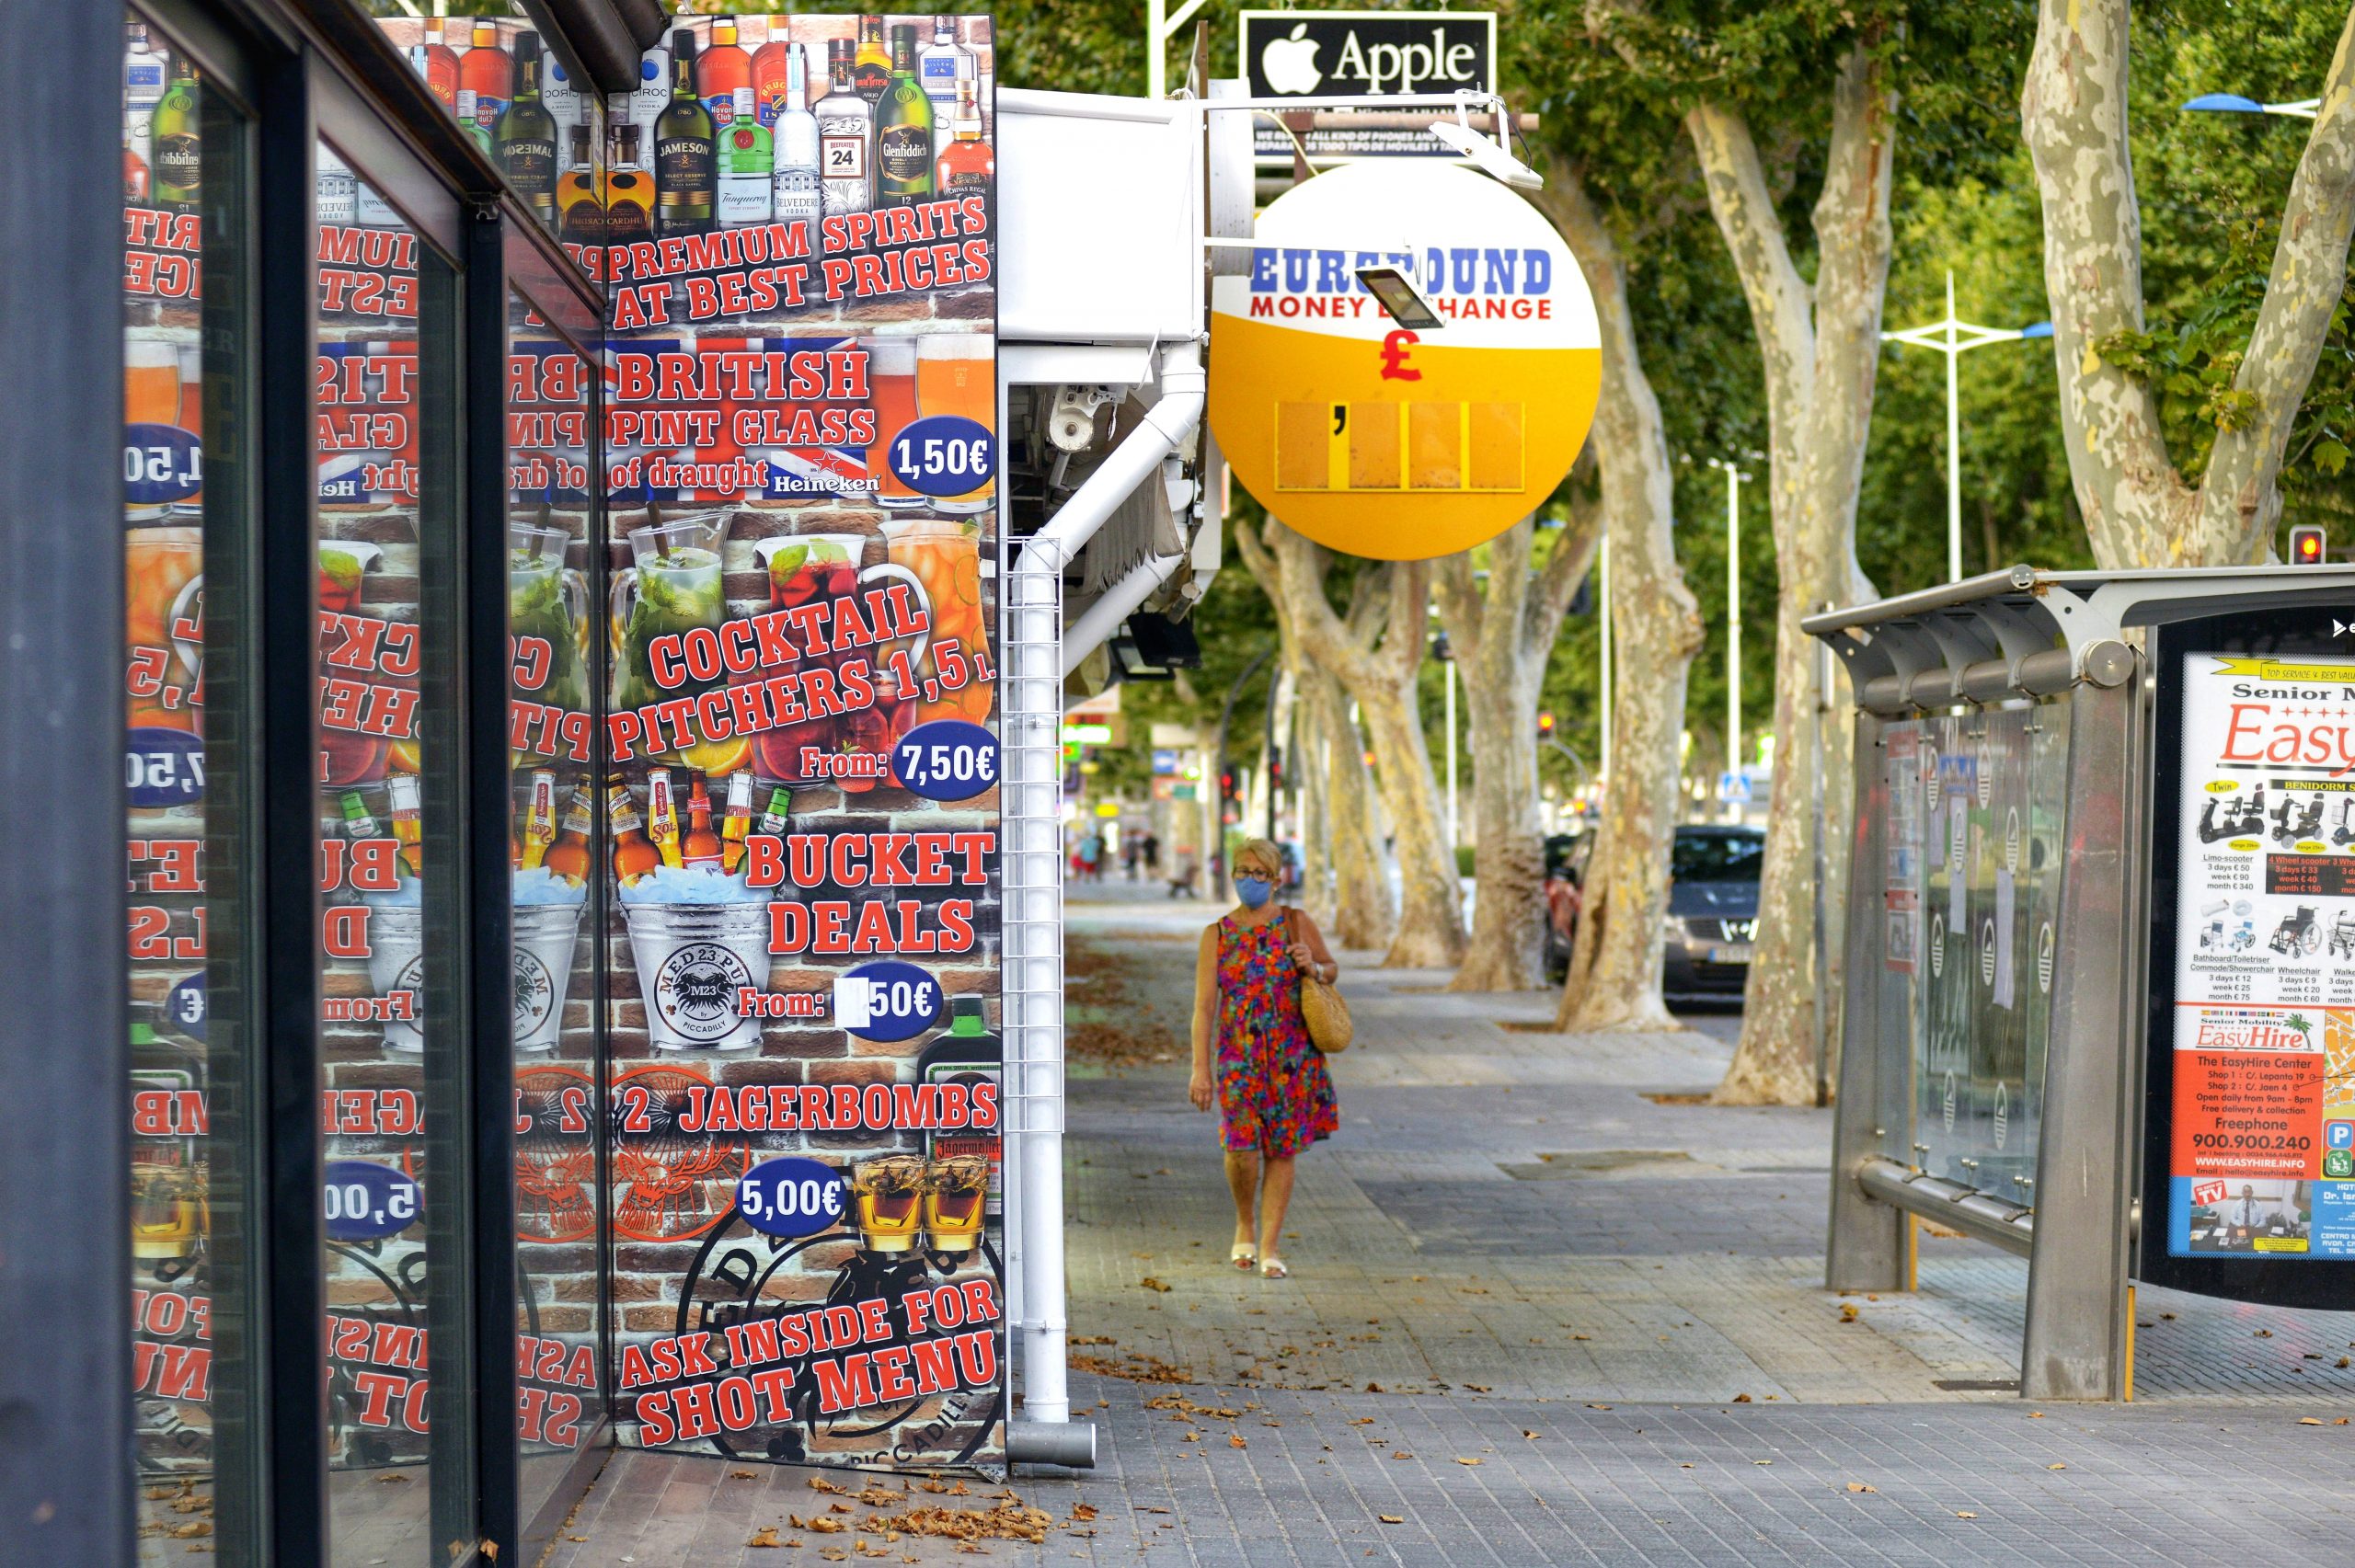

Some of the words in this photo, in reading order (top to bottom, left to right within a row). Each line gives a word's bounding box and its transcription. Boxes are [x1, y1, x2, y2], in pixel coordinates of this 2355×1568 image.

[1330, 28, 1476, 95] Apple
[711, 106, 733, 114] Havan
[660, 143, 710, 157] JAMESON
[832, 150, 854, 166] 24
[883, 143, 927, 157] Glenfiddich
[721, 192, 767, 205] Tanqueray
[948, 186, 969, 195] CHIVAS
[969, 186, 986, 194] REGAL
[902, 196, 911, 204] 12
[608, 221, 810, 281] PREMIUM
[821, 196, 987, 253] SPIRITS
[614, 282, 672, 331] AT
[687, 264, 809, 320] BEST
[821, 239, 992, 301] PRICES
[1249, 295, 1367, 318] MONEY
[1378, 297, 1552, 320] HANGE
[615, 350, 870, 401] BRITISH
[612, 410, 720, 447] PINT
[734, 408, 876, 446] GLASS
[896, 439, 989, 481] 1,50€
[611, 456, 642, 489] of
[649, 457, 769, 495] draught
[774, 475, 881, 493] Heineken
[649, 583, 929, 689] COCKTAIL
[2282, 670, 2311, 679] SERVICE
[2320, 671, 2337, 680] BEST
[607, 659, 875, 762] PITCHERS
[890, 639, 969, 703] 1,5
[2232, 683, 2332, 701] Senior
[799, 746, 889, 780] From:
[902, 744, 995, 786] 7,50€
[2212, 783, 2233, 792] Twin
[2284, 782, 2346, 792] BENIDORM
[745, 832, 995, 888] BUCKET
[2202, 853, 2254, 863] Limo-scooter
[2276, 856, 2299, 864] Wheel
[2301, 857, 2330, 865] scooter
[2213, 864, 2232, 872] days
[766, 898, 975, 955] DEALS
[660, 952, 695, 994] MED
[697, 948, 717, 962] 23
[2278, 967, 2321, 976] Wheelchair
[691, 986, 717, 996] M23
[737, 987, 825, 1018] From:
[683, 1020, 726, 1033] PICCADILLY
[2238, 1019, 2283, 1027] Mobility
[2197, 1025, 2303, 1050] EasyHire
[2198, 1056, 2218, 1067] The
[2222, 1057, 2270, 1070] EasyHire
[2275, 1058, 2312, 1069] Center
[2208, 1070, 2229, 1080] Shop
[2259, 1072, 2293, 1082] Lepanto
[2295, 1072, 2304, 1081] 19
[2208, 1082, 2228, 1091] Shop
[624, 1086, 650, 1132] 2
[678, 1082, 999, 1132] JAGERBOMBS
[2196, 1093, 2218, 1103] Open
[2221, 1093, 2242, 1103] daily
[2267, 1094, 2285, 1103] 9am
[2294, 1095, 2313, 1104] 8pm
[2201, 1104, 2219, 1113] Free
[2222, 1104, 2254, 1115] delivery
[2266, 1106, 2306, 1115] collection
[2215, 1117, 2288, 1132] Freephone
[2192, 1133, 2311, 1150] 900.900.240
[741, 1179, 842, 1221] 5,00€
[2198, 1185, 2223, 1204] TV
[620, 1331, 718, 1390] ASK
[724, 1297, 897, 1369] INSIDE
[902, 1279, 1000, 1335] FOR
[636, 1367, 795, 1448] SHOT
[813, 1329, 998, 1414] MENU
